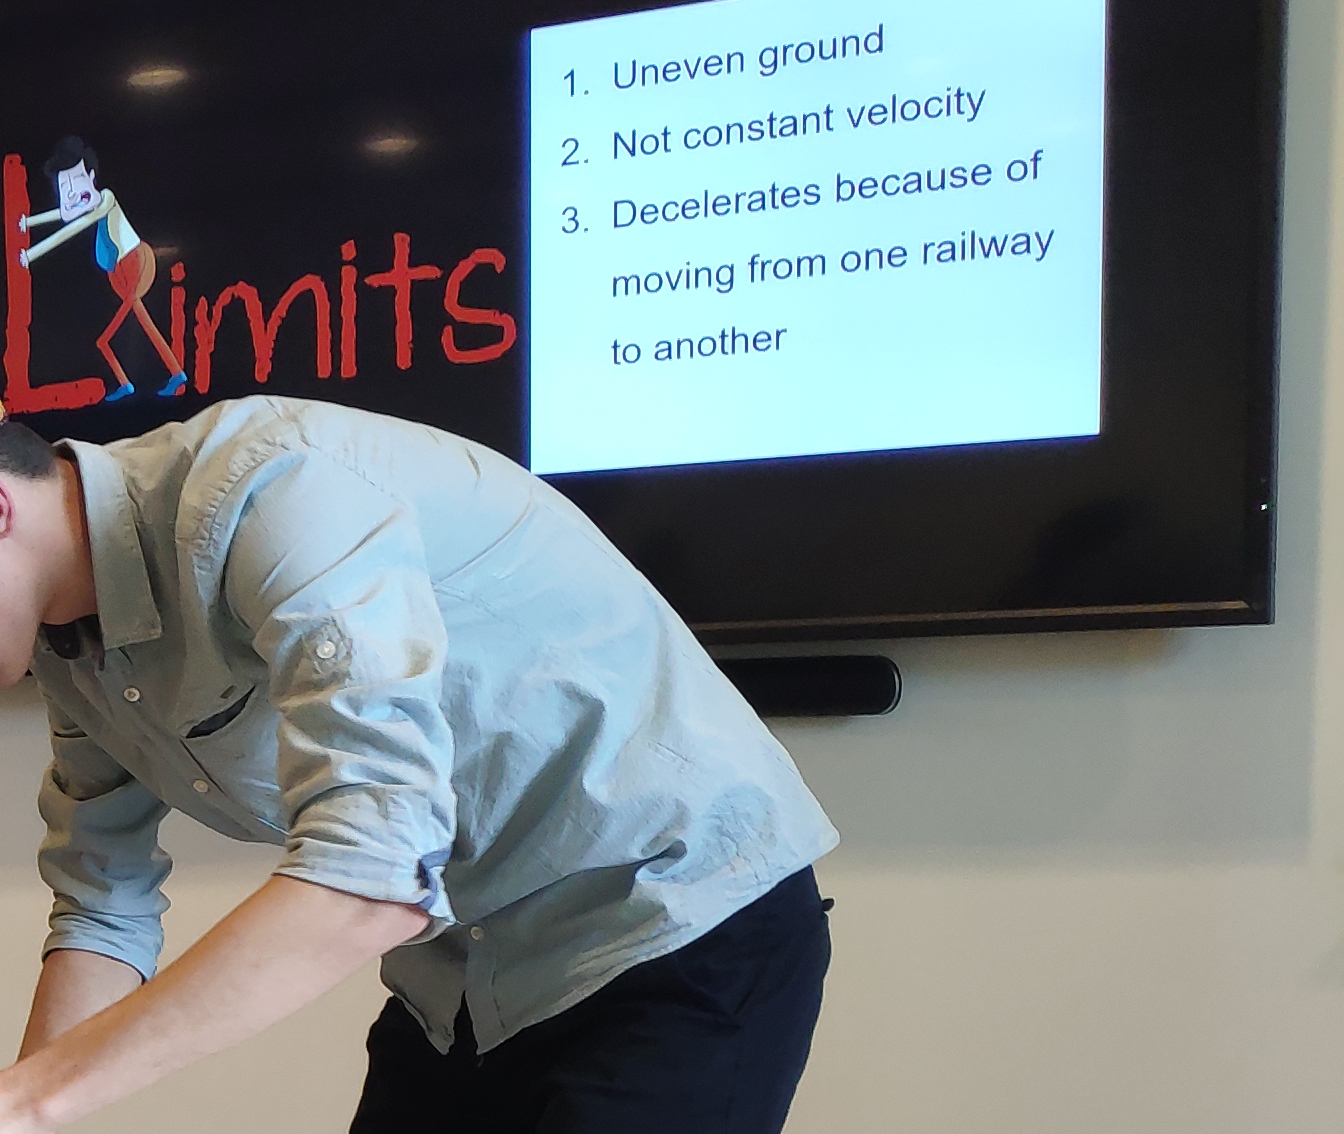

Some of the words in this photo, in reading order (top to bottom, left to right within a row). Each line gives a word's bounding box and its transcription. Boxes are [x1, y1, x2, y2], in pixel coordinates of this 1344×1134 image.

[563, 67, 590, 98] 1.
[613, 51, 745, 90] Uneven
[758, 22, 884, 77] ground
[561, 137, 589, 167] 2.
[613, 125, 672, 160] Not
[683, 103, 835, 150] constant
[846, 86, 987, 129] velocity
[561, 206, 589, 234] 3.
[613, 181, 821, 229] Decelerates
[836, 163, 993, 203] because
[1006, 148, 1044, 182] of
[3, 152, 517, 414] Limits
[612, 260, 735, 298] moving
[747, 253, 826, 284] from
[840, 245, 908, 273] one
[922, 228, 1055, 265] railway
[611, 338, 642, 366] to
[654, 325, 788, 362] another
